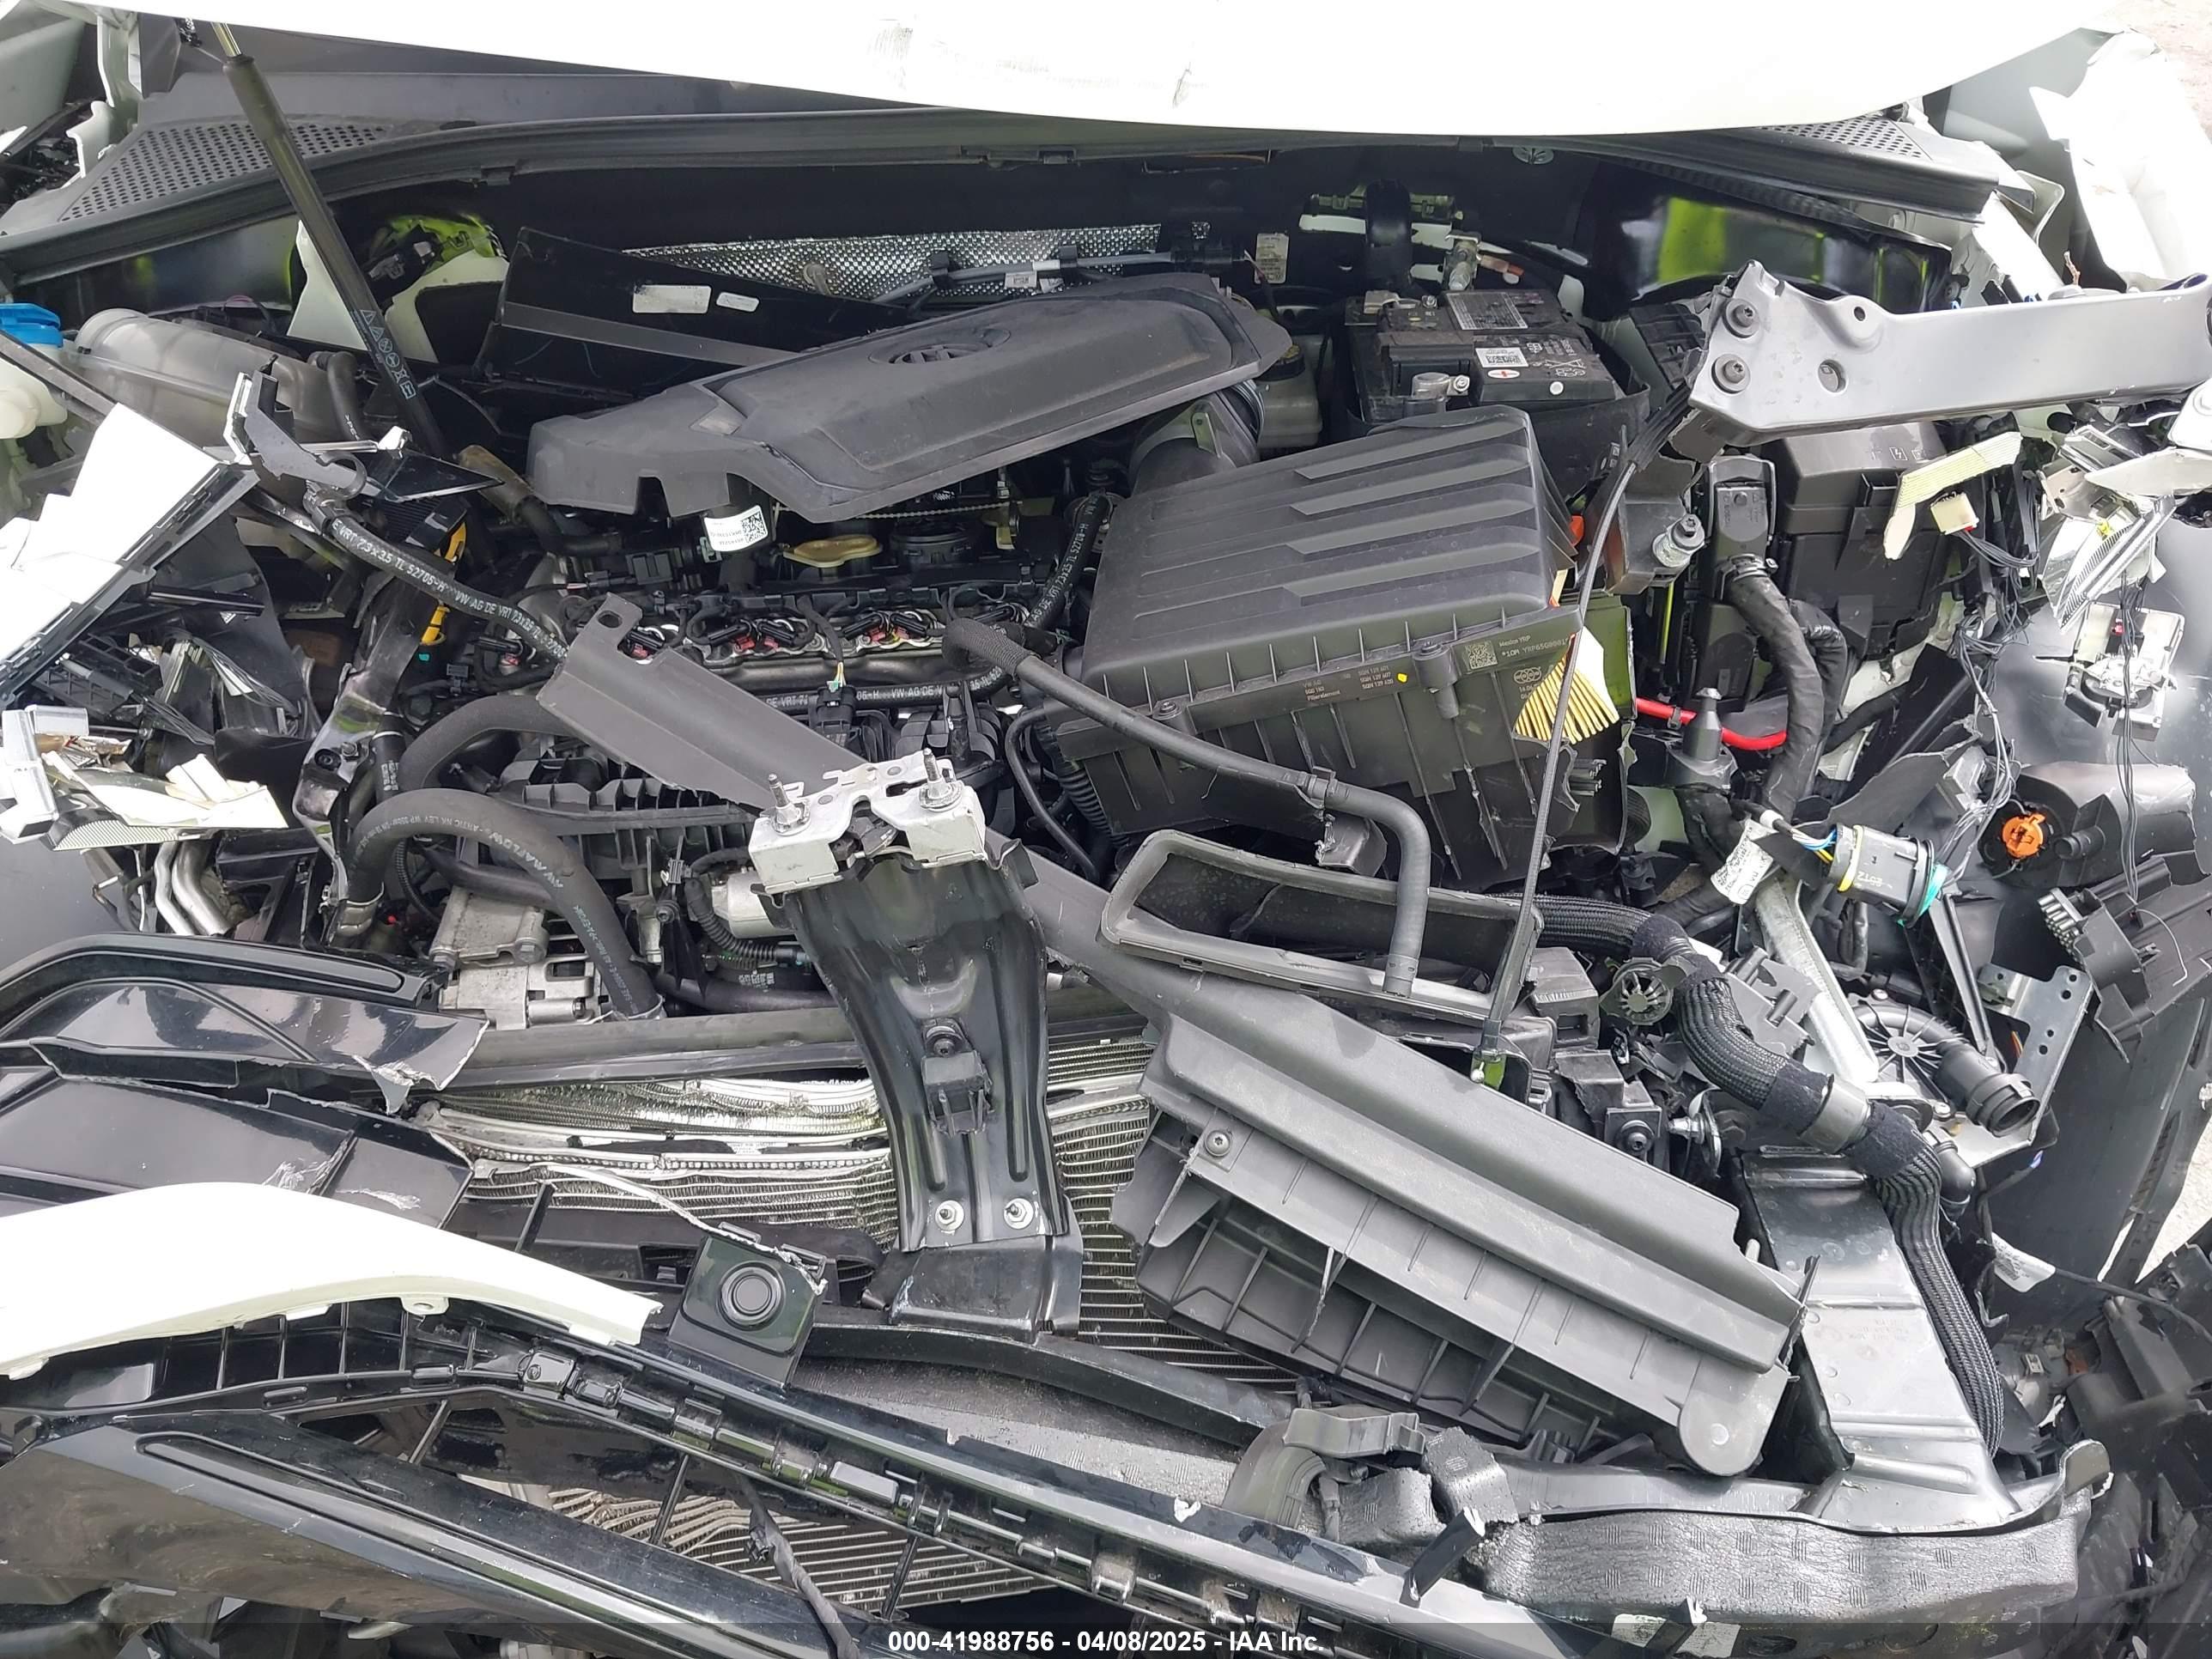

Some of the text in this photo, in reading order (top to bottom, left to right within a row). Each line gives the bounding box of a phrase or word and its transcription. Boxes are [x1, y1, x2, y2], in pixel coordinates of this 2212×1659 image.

[339, 525, 358, 543] VRT
[395, 556, 408, 571] TL
[454, 590, 471, 605] VW
[470, 598, 483, 611] AG
[483, 601, 497, 615] DE
